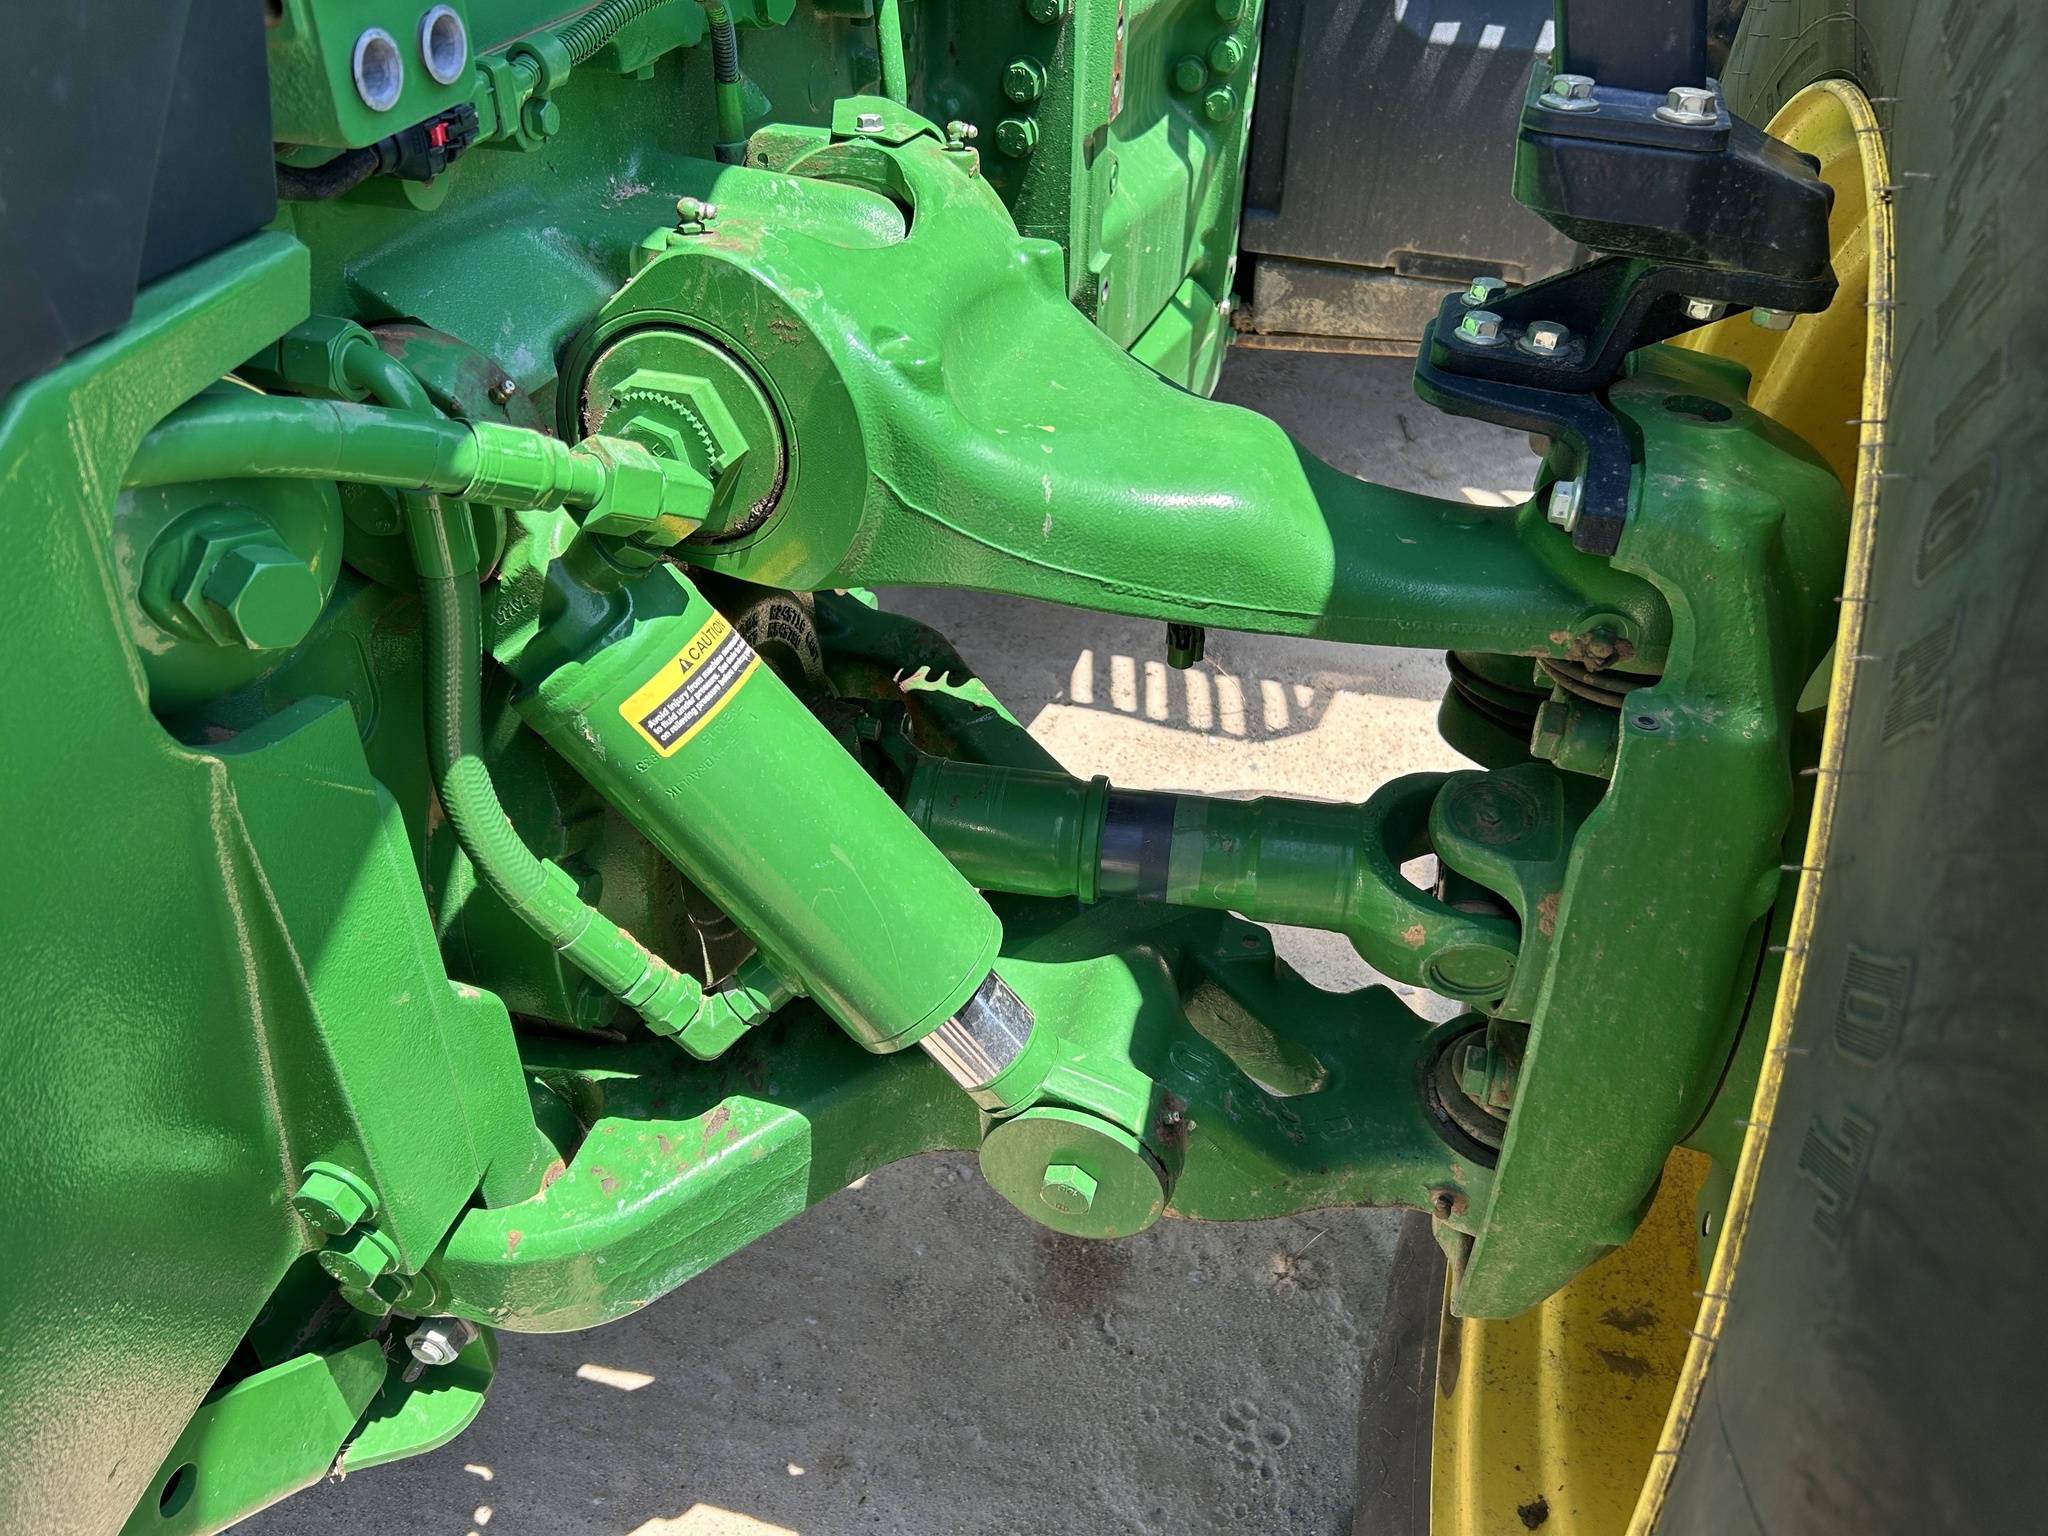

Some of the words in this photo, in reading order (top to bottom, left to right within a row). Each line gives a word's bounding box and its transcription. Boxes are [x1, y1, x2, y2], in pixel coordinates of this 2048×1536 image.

[687, 617, 726, 662] CAUTION
[646, 706, 670, 729] Avoid
[666, 688, 690, 711] injury
[685, 674, 704, 693] from
[699, 652, 725, 679] machine
[653, 724, 663, 735] to
[660, 710, 678, 729] fluid
[674, 694, 695, 715] under
[692, 670, 720, 700] pressure.
[659, 730, 671, 742] on
[667, 704, 699, 734] relieving
[694, 682, 721, 711] pressure
[716, 666, 734, 686] before
[634, 749, 662, 775] 833
